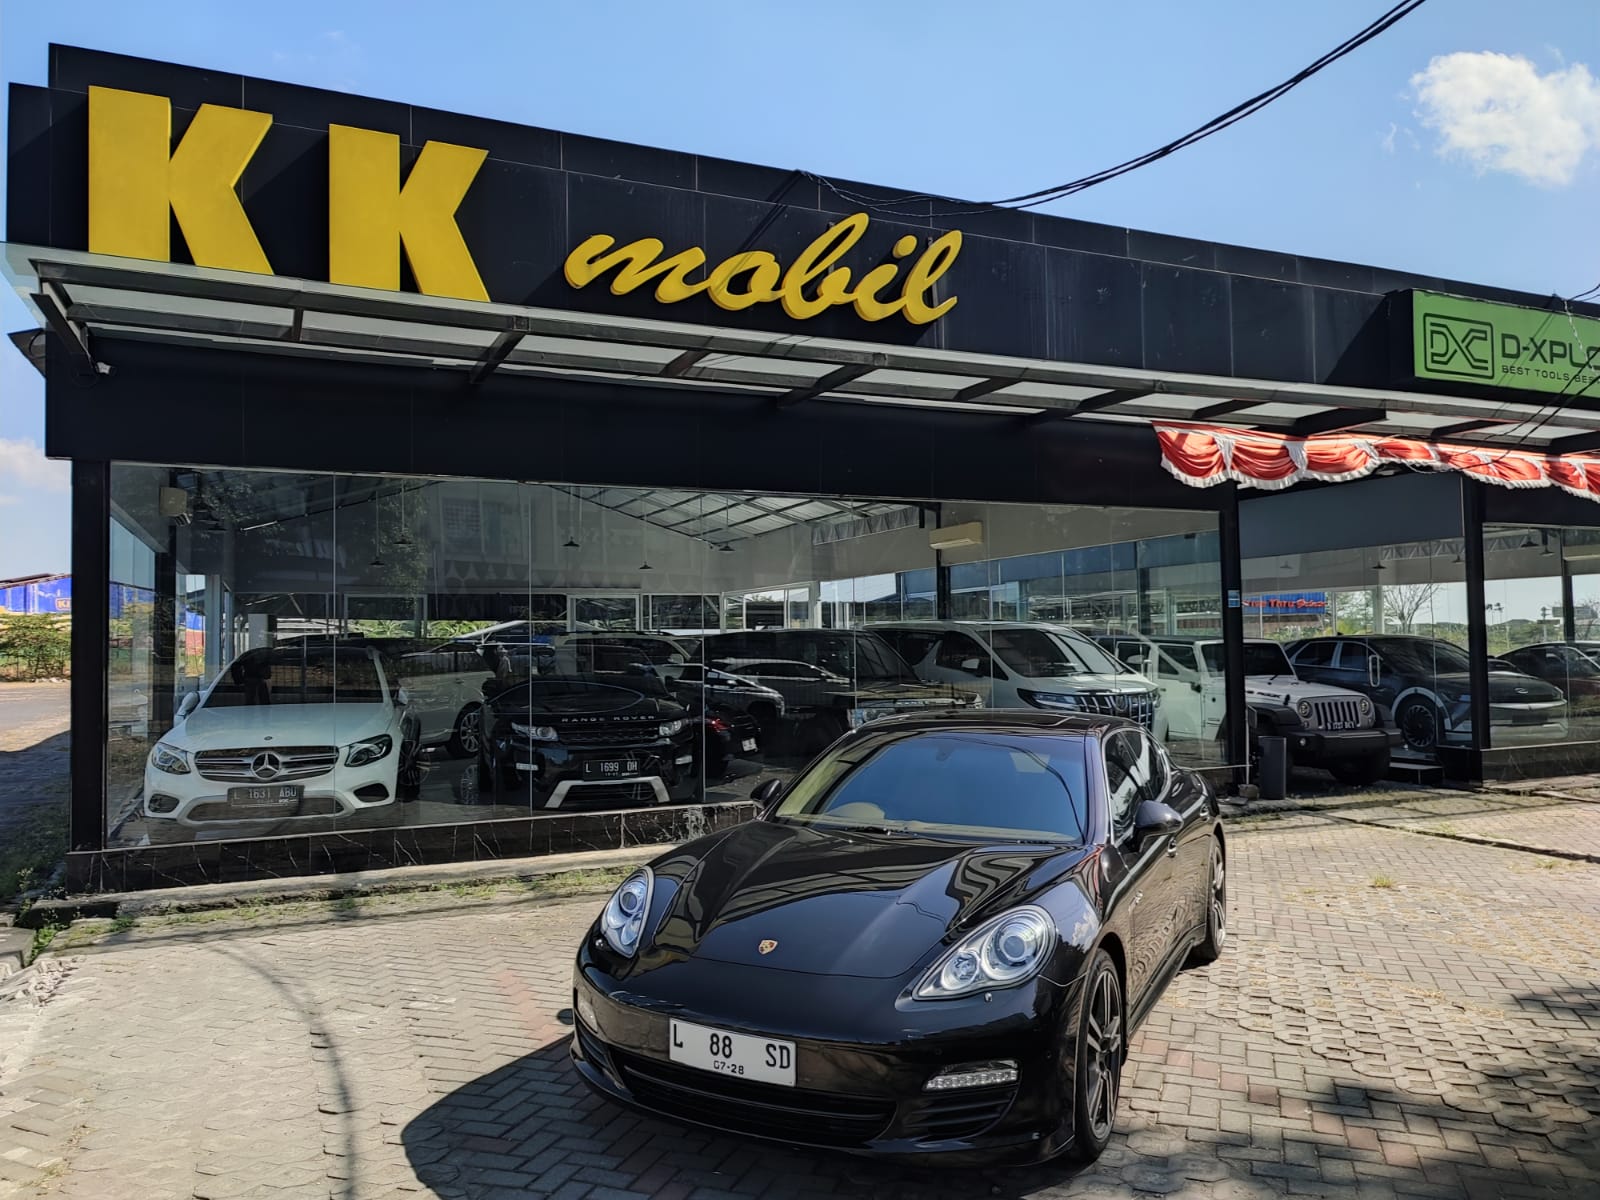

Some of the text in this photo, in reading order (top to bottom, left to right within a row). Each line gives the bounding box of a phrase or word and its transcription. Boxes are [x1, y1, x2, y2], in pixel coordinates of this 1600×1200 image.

[89, 85, 491, 302] KK
[564, 212, 962, 325] mobil
[1502, 365, 1530, 376] BEST
[1535, 369, 1569, 381] TOOLS
[586, 763, 592, 773] L
[601, 762, 619, 772] 1699
[249, 788, 271, 799] 1631
[673, 1023, 791, 1069] L 88 SD
